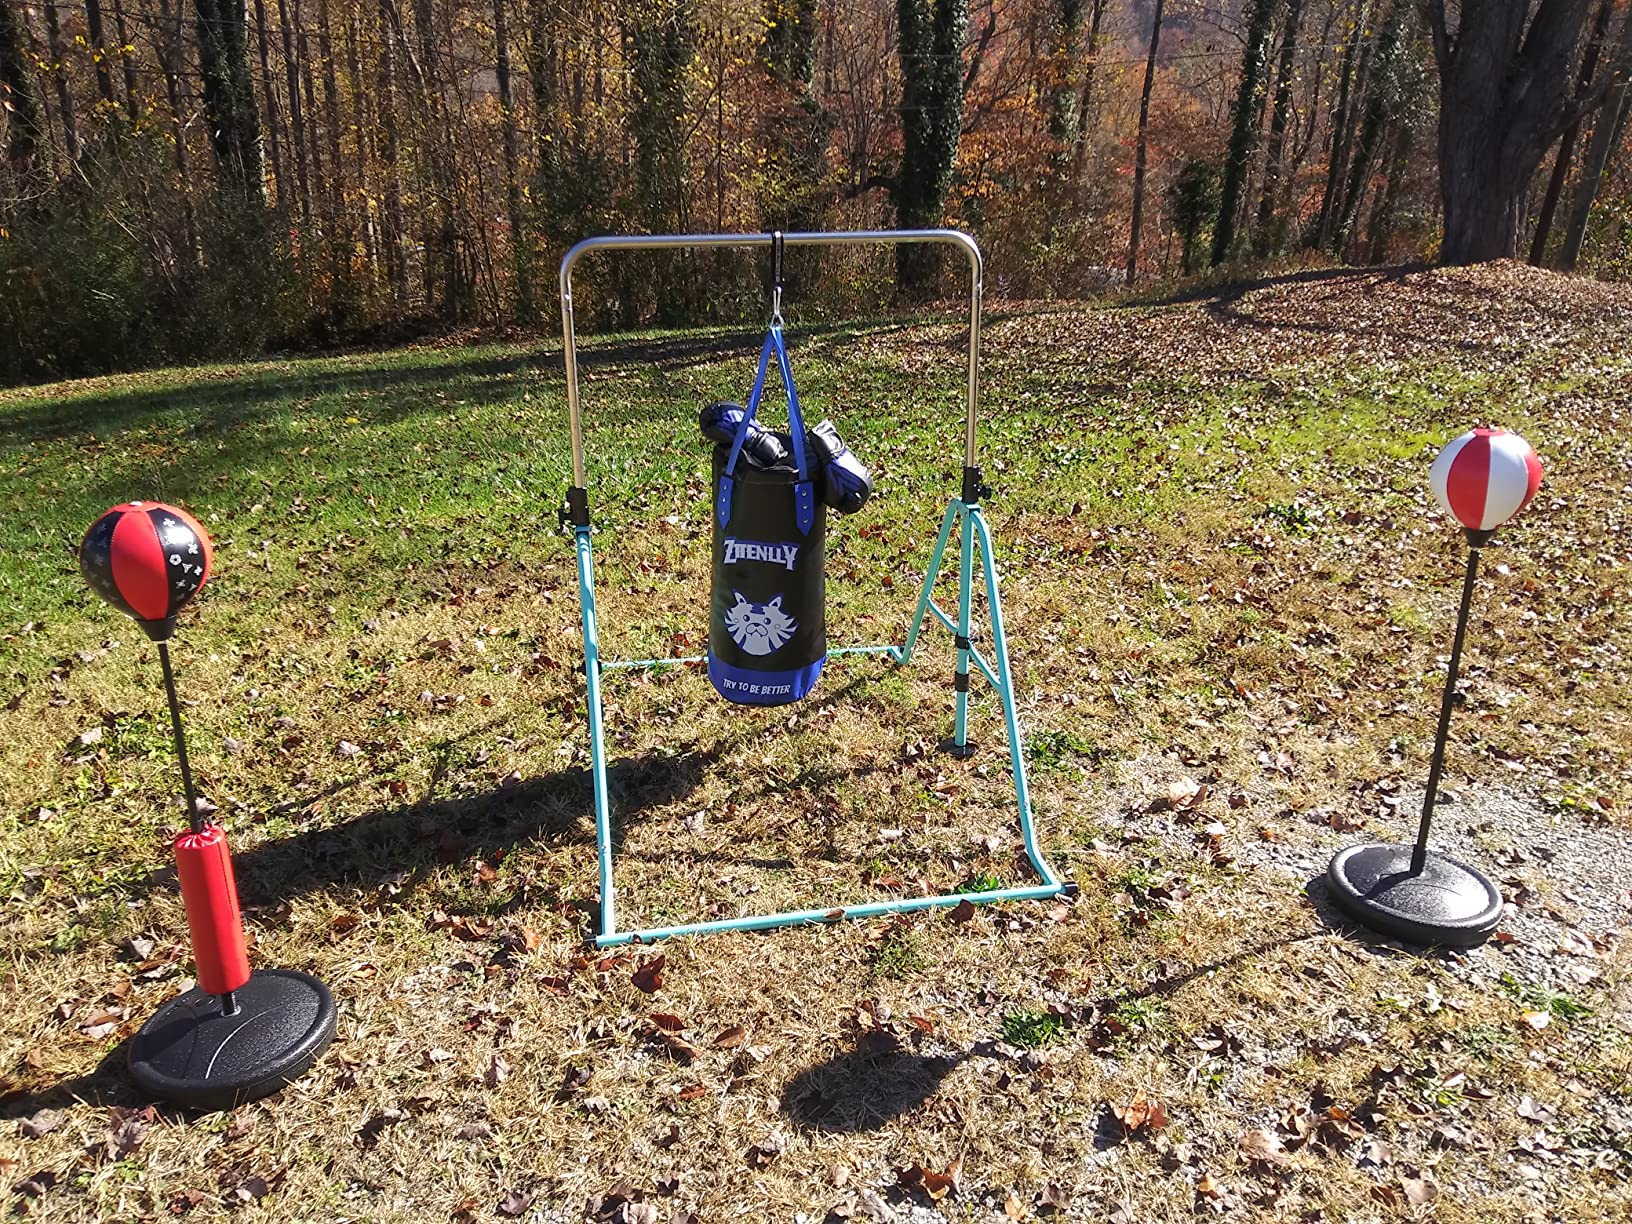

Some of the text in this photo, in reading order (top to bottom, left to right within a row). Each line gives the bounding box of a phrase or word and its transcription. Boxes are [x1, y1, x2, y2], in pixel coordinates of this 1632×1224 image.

[723, 678, 791, 695] TRY TO BE BETTER
